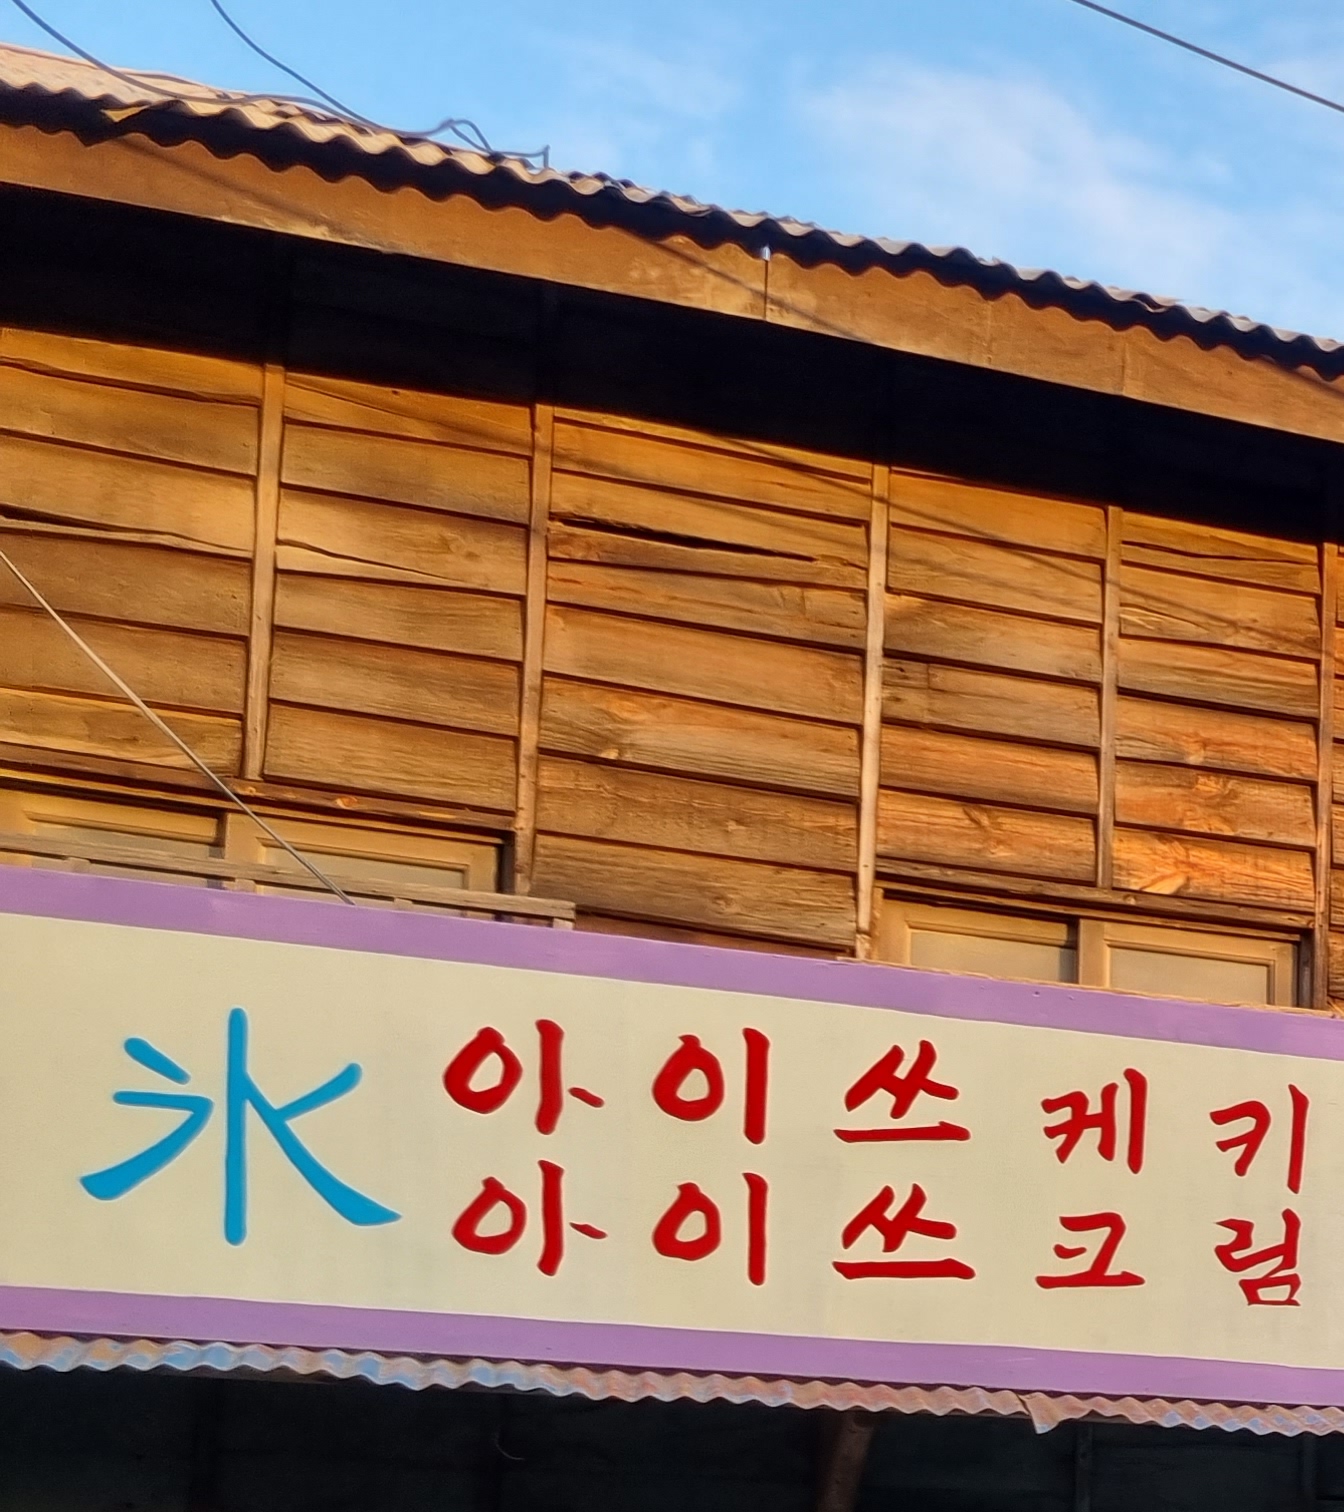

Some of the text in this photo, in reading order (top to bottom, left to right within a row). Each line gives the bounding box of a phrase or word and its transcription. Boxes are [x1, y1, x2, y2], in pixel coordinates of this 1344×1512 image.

[80, 1007, 401, 1245] 氷
[443, 1019, 1310, 1193] 아이쓰케키
[451, 1159, 1303, 1307] 아이쓰크림
